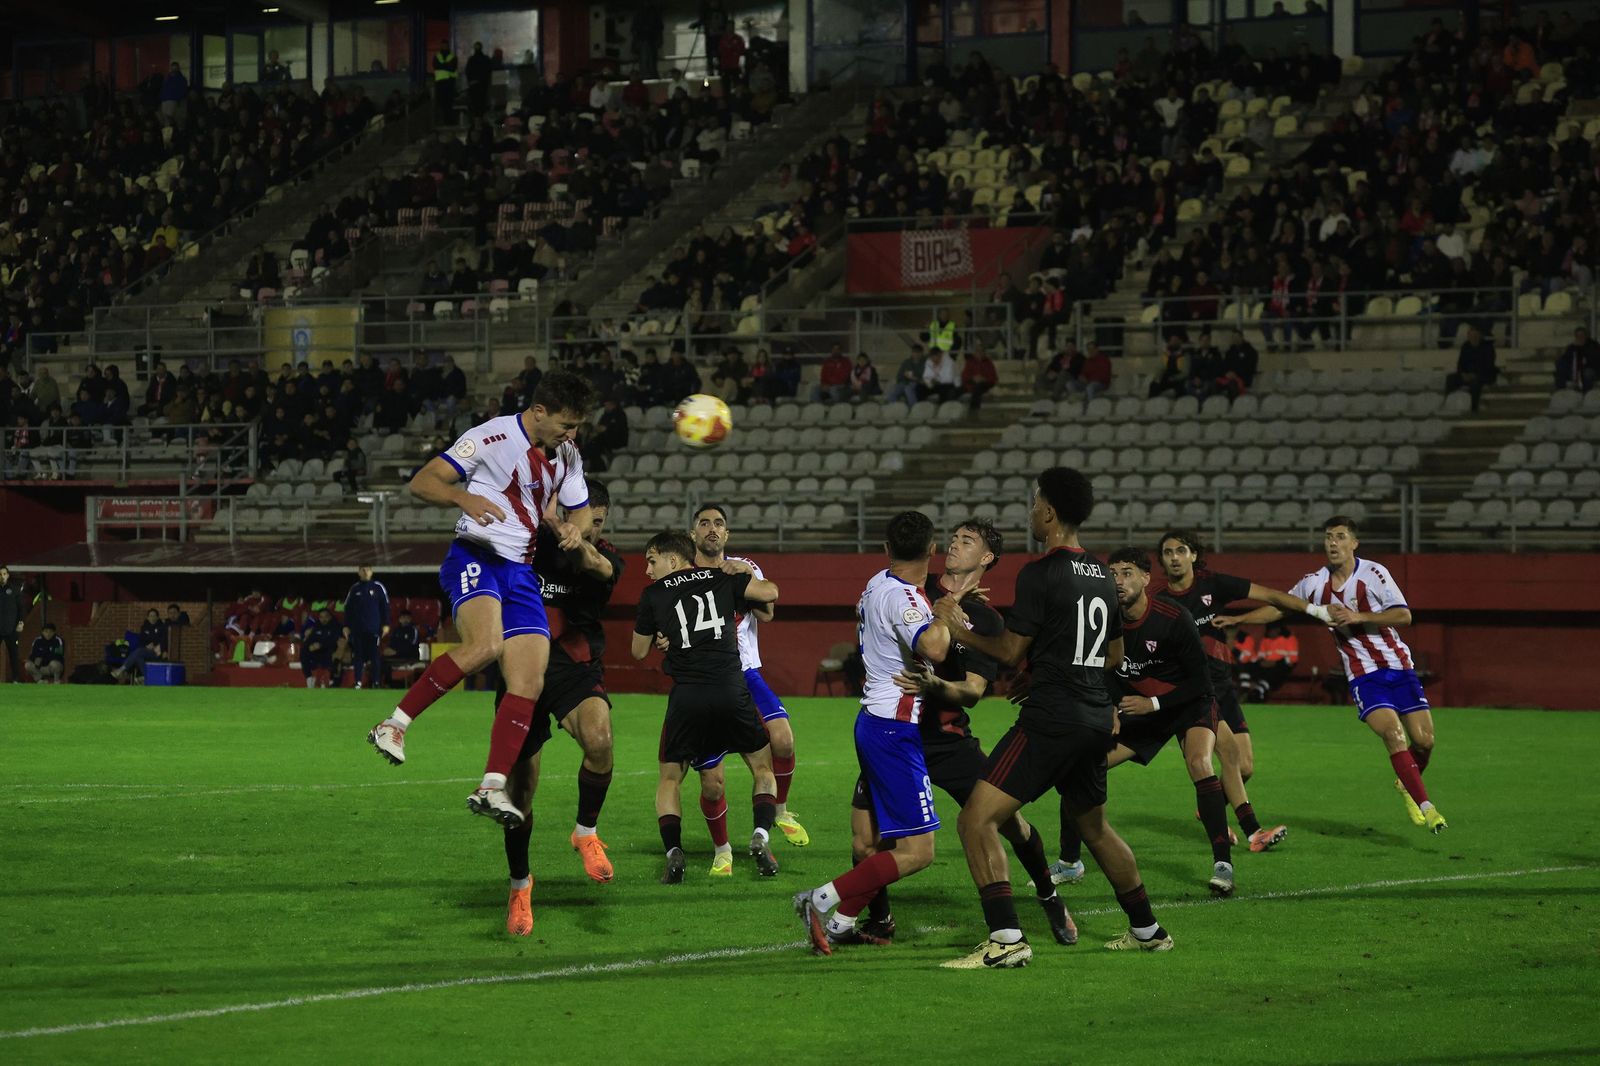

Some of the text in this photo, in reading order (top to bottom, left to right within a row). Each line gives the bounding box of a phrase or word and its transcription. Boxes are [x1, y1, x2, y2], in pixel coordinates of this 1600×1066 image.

[664, 570, 713, 588] R.JALADE
[1071, 560, 1105, 578] MIGUEL
[674, 590, 725, 649] 14
[1072, 595, 1108, 667] 12
[922, 774, 933, 802] 8
